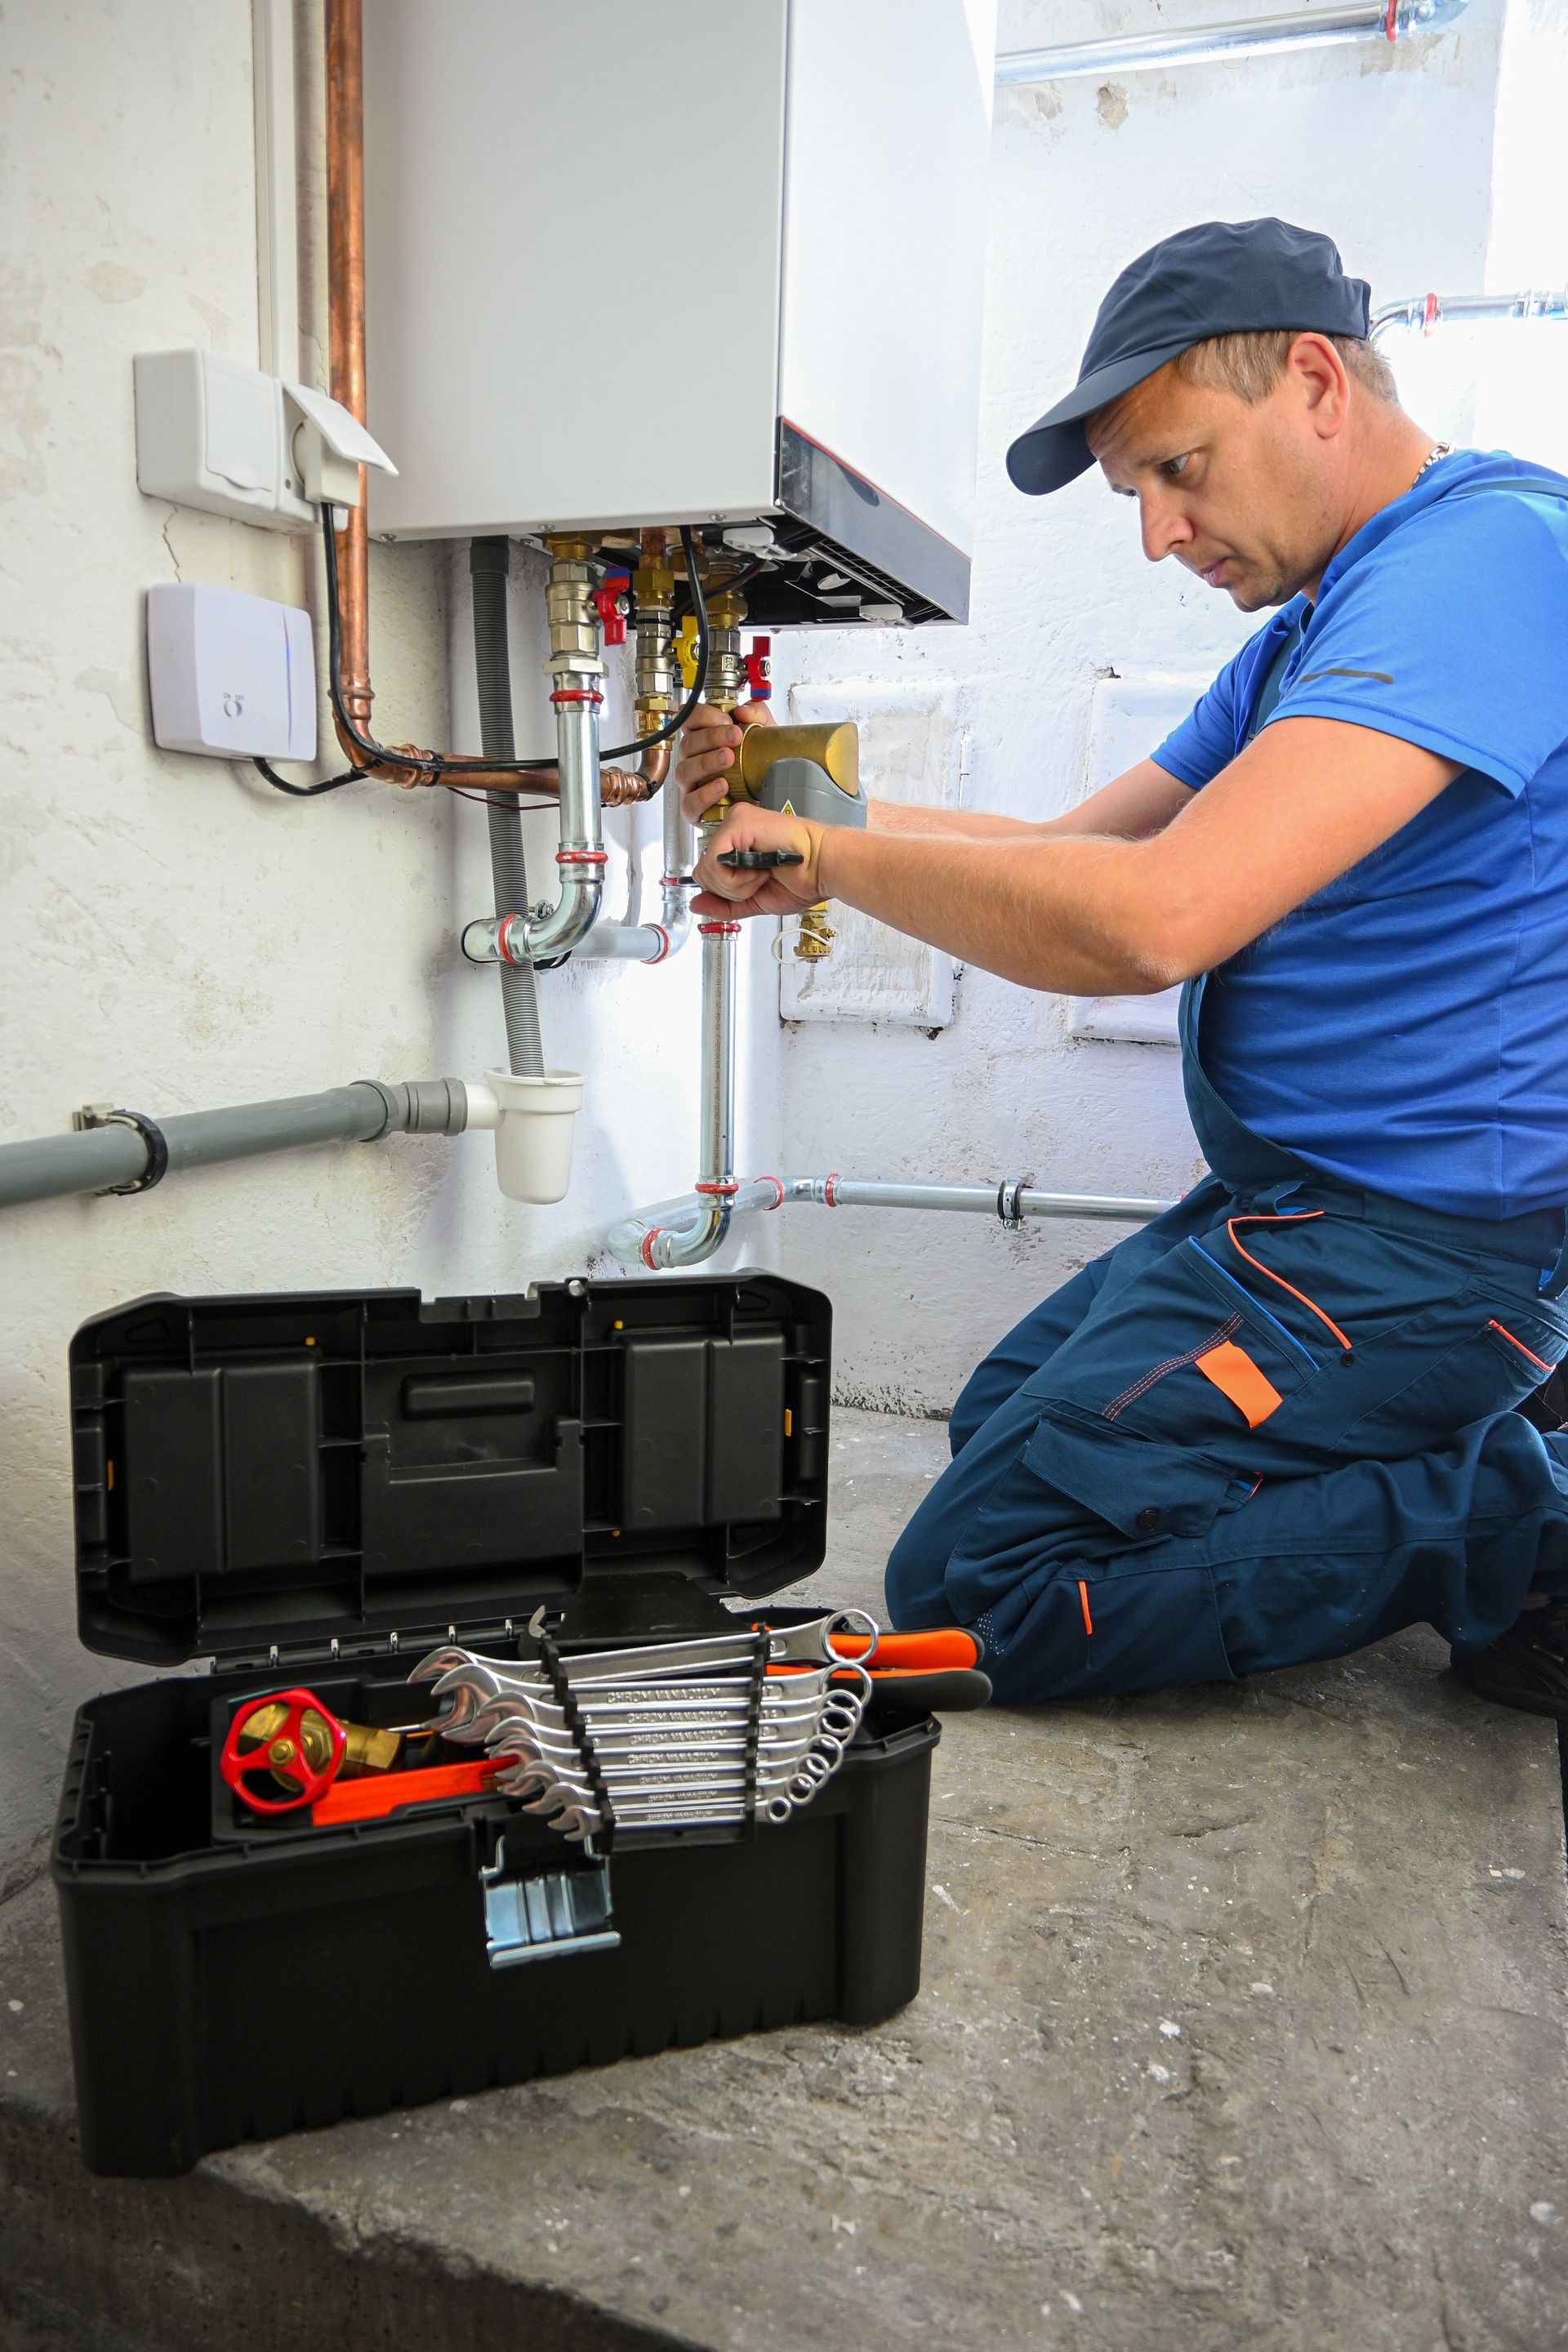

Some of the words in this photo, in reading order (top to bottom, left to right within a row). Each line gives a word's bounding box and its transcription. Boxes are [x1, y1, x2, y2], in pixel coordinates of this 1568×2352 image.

[607, 1690, 652, 1704] CHROM
[655, 1687, 721, 1699] VANADIUM
[627, 1713, 667, 1724] CHROM
